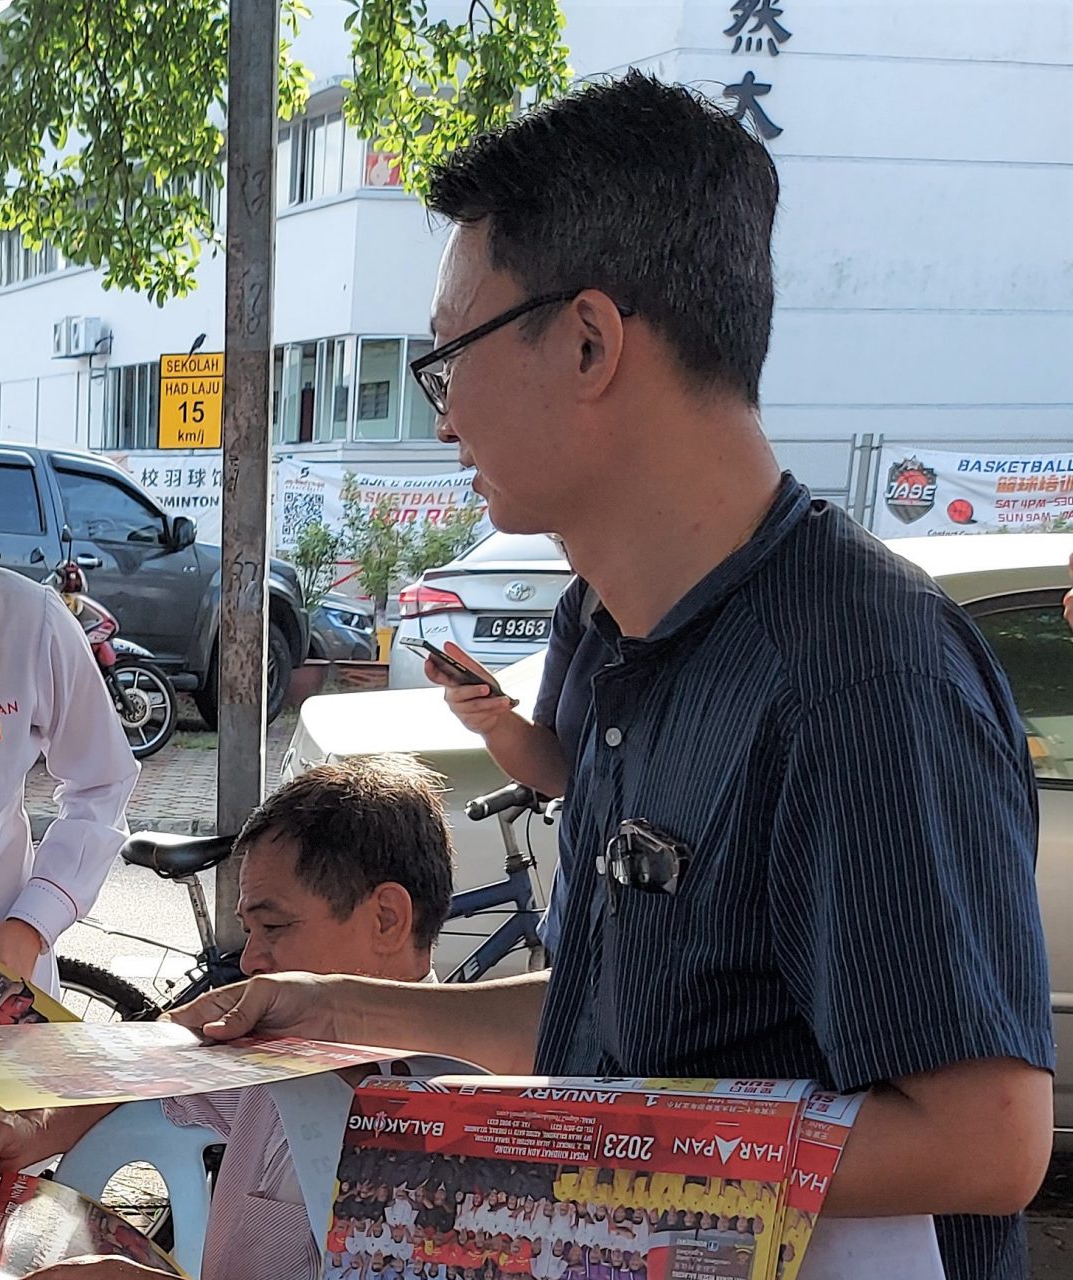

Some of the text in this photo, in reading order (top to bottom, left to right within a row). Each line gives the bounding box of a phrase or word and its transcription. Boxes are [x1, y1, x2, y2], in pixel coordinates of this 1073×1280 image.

[166, 359, 219, 373] SEKOLAH
[165, 382, 219, 396] HAD LAJU
[178, 401, 205, 424] 15
[178, 429, 205, 445] km/j
[957, 459, 1073, 474] BASKETBALL
[995, 499, 1019, 509] SAT
[998, 513, 1023, 522] SUN
[492, 620, 546, 636] G 9363
[519, 1088, 660, 1107] 1 JANUARY
[348, 1112, 783, 1165] HARAPAN 2023 BALAKONG
